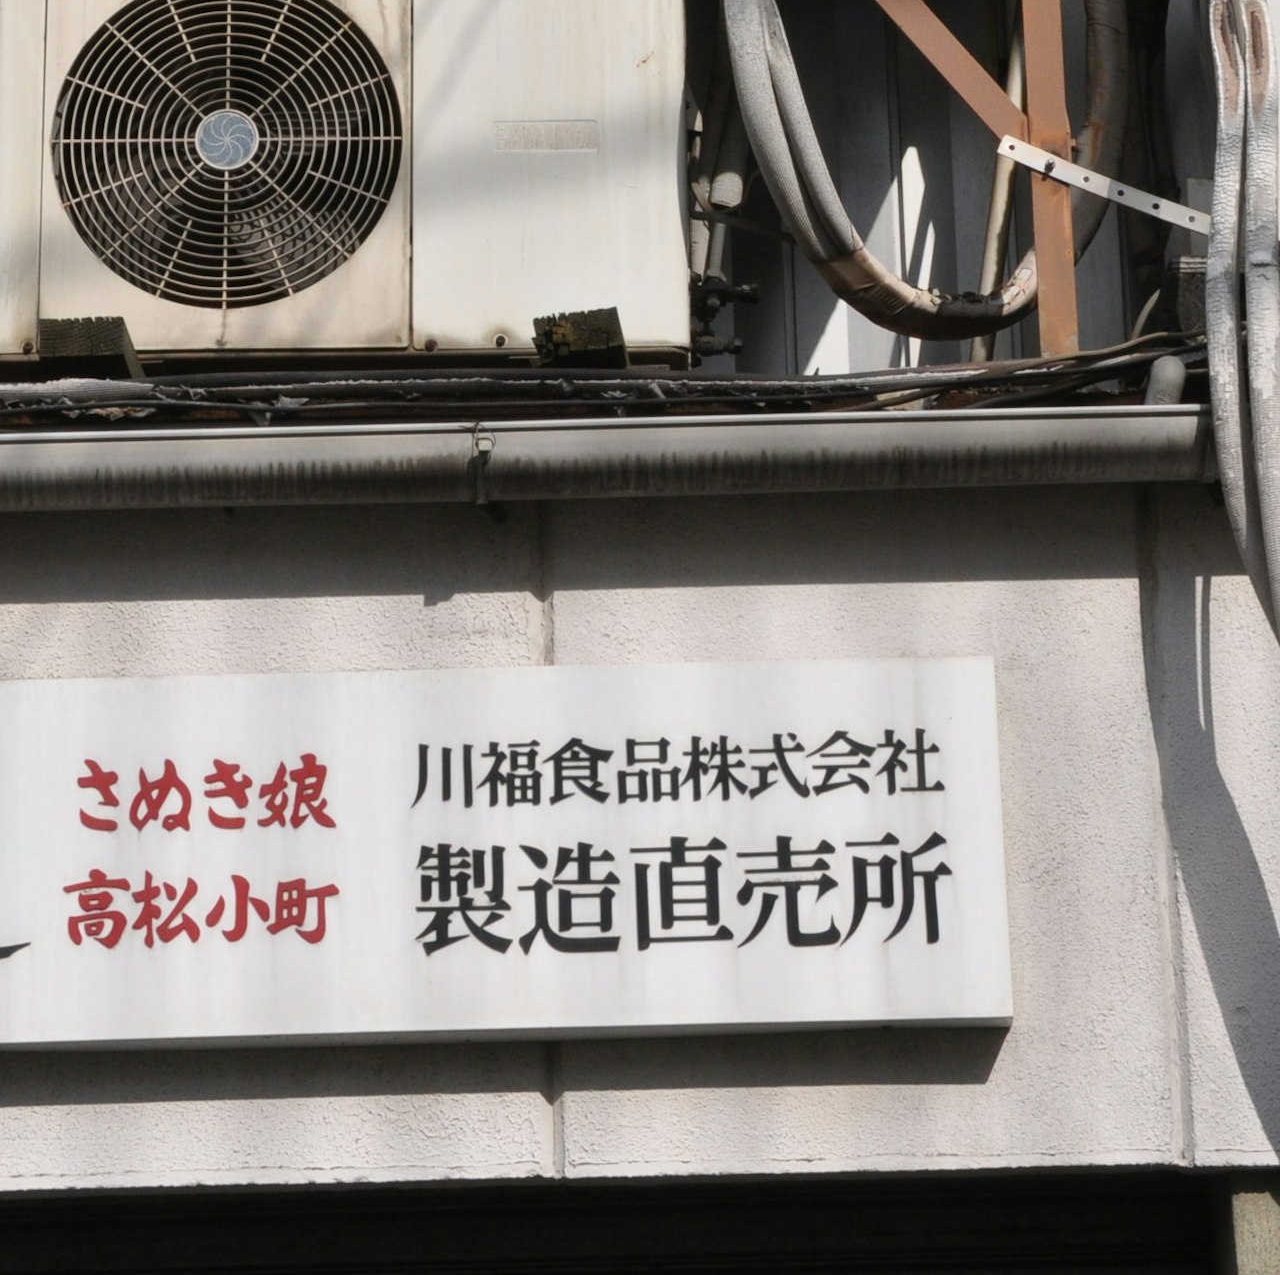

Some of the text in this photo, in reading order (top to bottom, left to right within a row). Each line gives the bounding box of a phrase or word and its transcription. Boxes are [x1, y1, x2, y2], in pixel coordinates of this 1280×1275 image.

[77, 753, 337, 831] さぬき娘
[410, 728, 946, 809] 川福食品株式会社
[63, 869, 340, 949] 高松小町
[415, 831, 953, 956] 製造直売所
